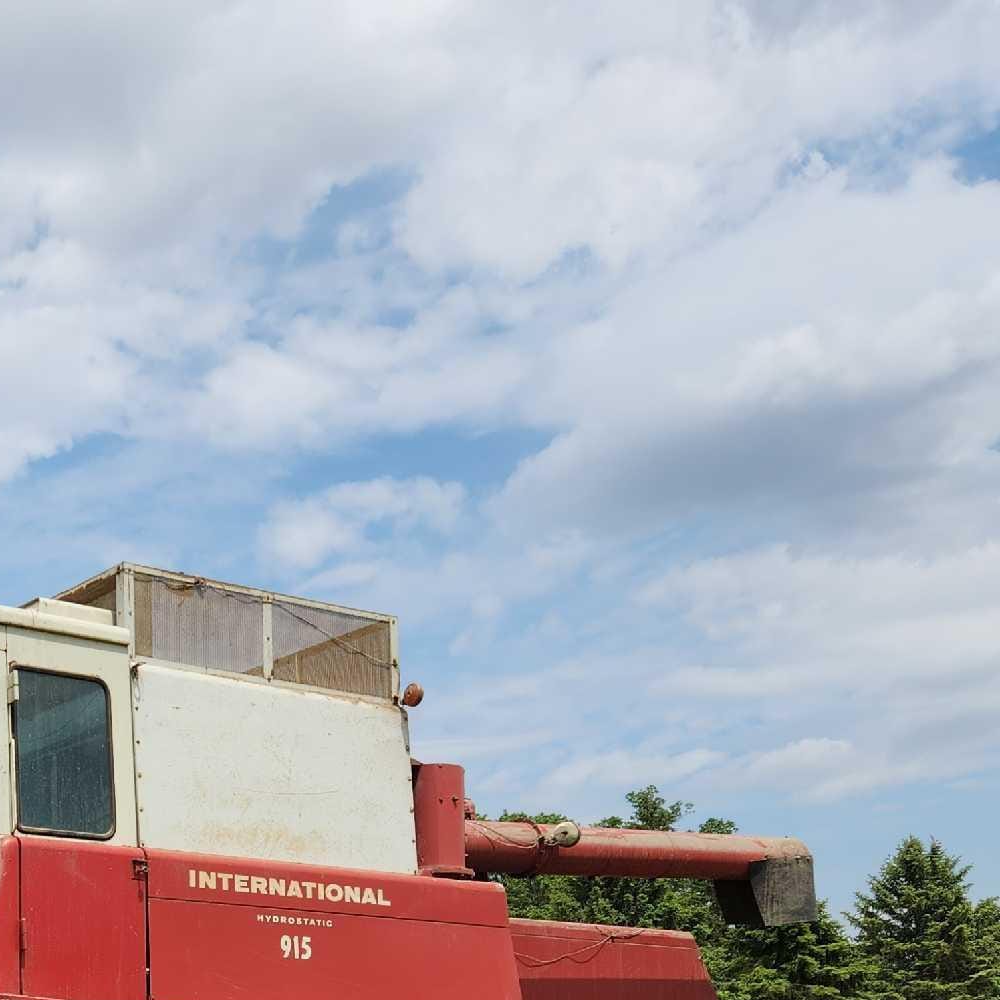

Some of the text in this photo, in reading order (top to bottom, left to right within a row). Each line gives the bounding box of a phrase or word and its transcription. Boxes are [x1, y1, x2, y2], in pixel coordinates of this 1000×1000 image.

[188, 870, 391, 906] INTERNATIONAL
[257, 914, 333, 927] HYDROSTATIC
[280, 935, 312, 960] 915
